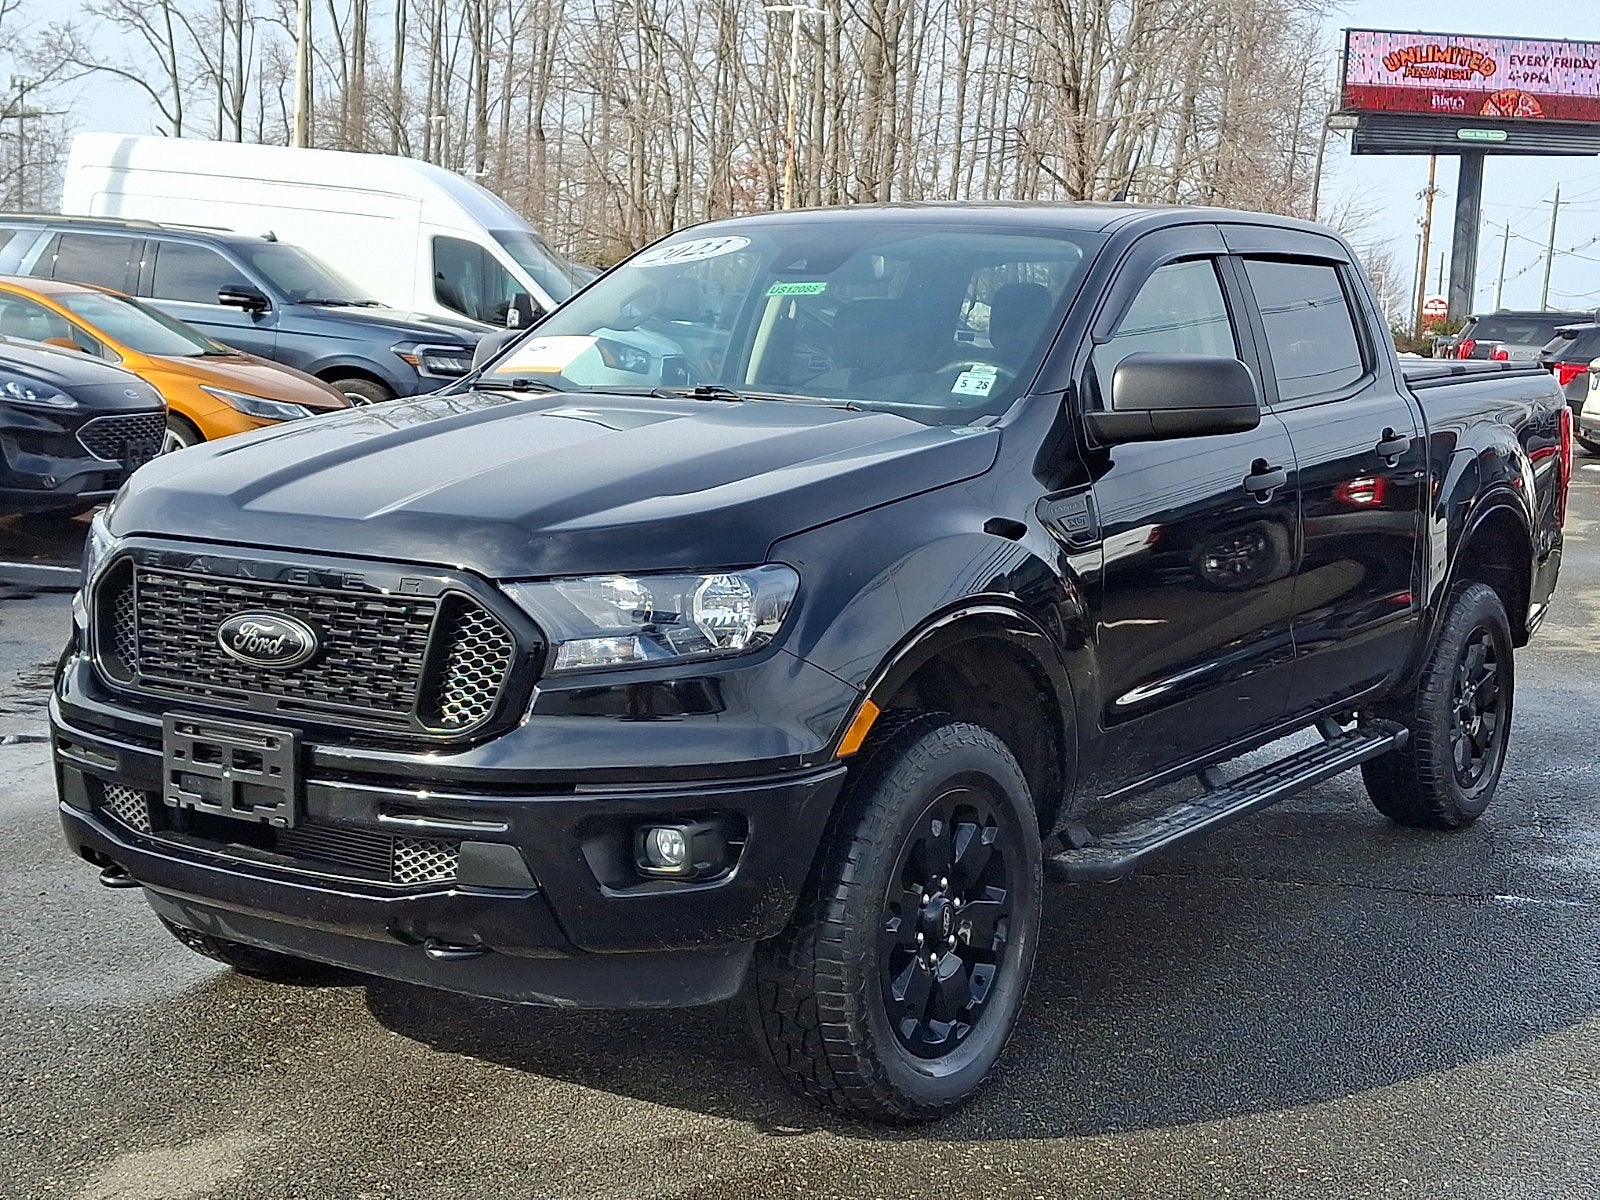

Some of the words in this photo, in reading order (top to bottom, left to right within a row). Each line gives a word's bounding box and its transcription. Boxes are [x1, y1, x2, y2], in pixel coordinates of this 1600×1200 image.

[1382, 45, 1497, 77] UNLIMITED
[1509, 54, 1550, 67] EVERY
[1553, 57, 1597, 70] FRIDAY
[1438, 67, 1474, 81] NIGHT
[960, 379, 969, 388] 5
[233, 621, 286, 655] Ford
